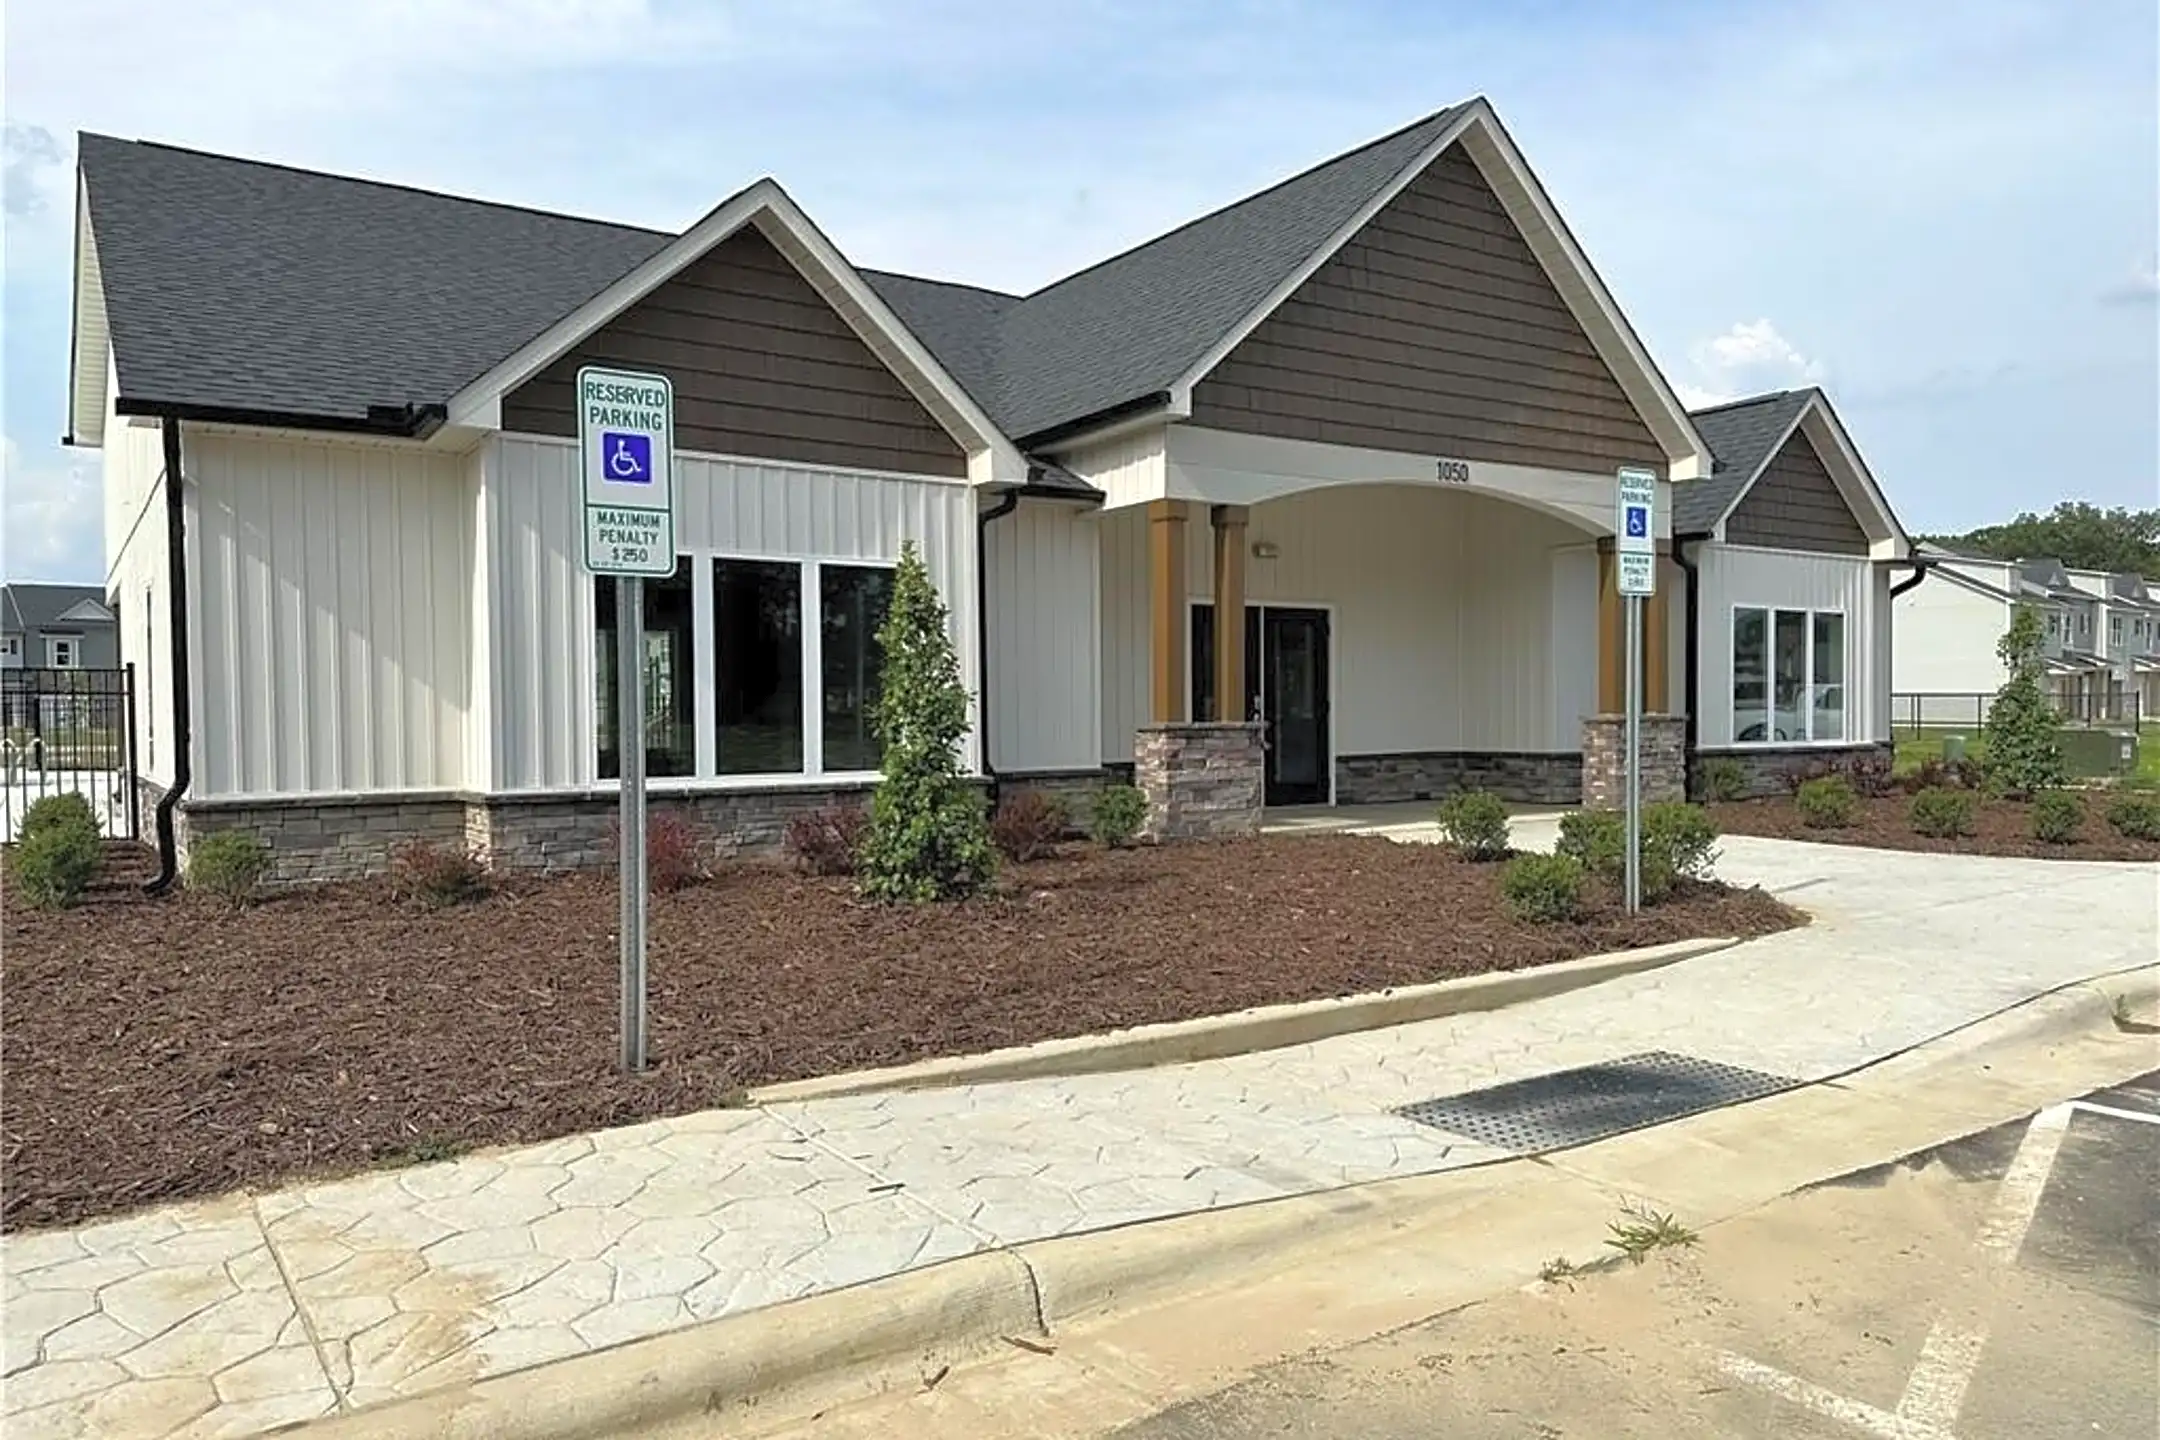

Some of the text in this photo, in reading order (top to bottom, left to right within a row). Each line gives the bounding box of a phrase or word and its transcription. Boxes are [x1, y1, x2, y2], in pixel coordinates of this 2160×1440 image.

[585, 382, 665, 407] RESERVED
[590, 406, 662, 431] PARKING
[1437, 461, 1469, 482] 1050
[597, 511, 660, 528] MAXIMUM
[599, 528, 659, 545] PENALTY
